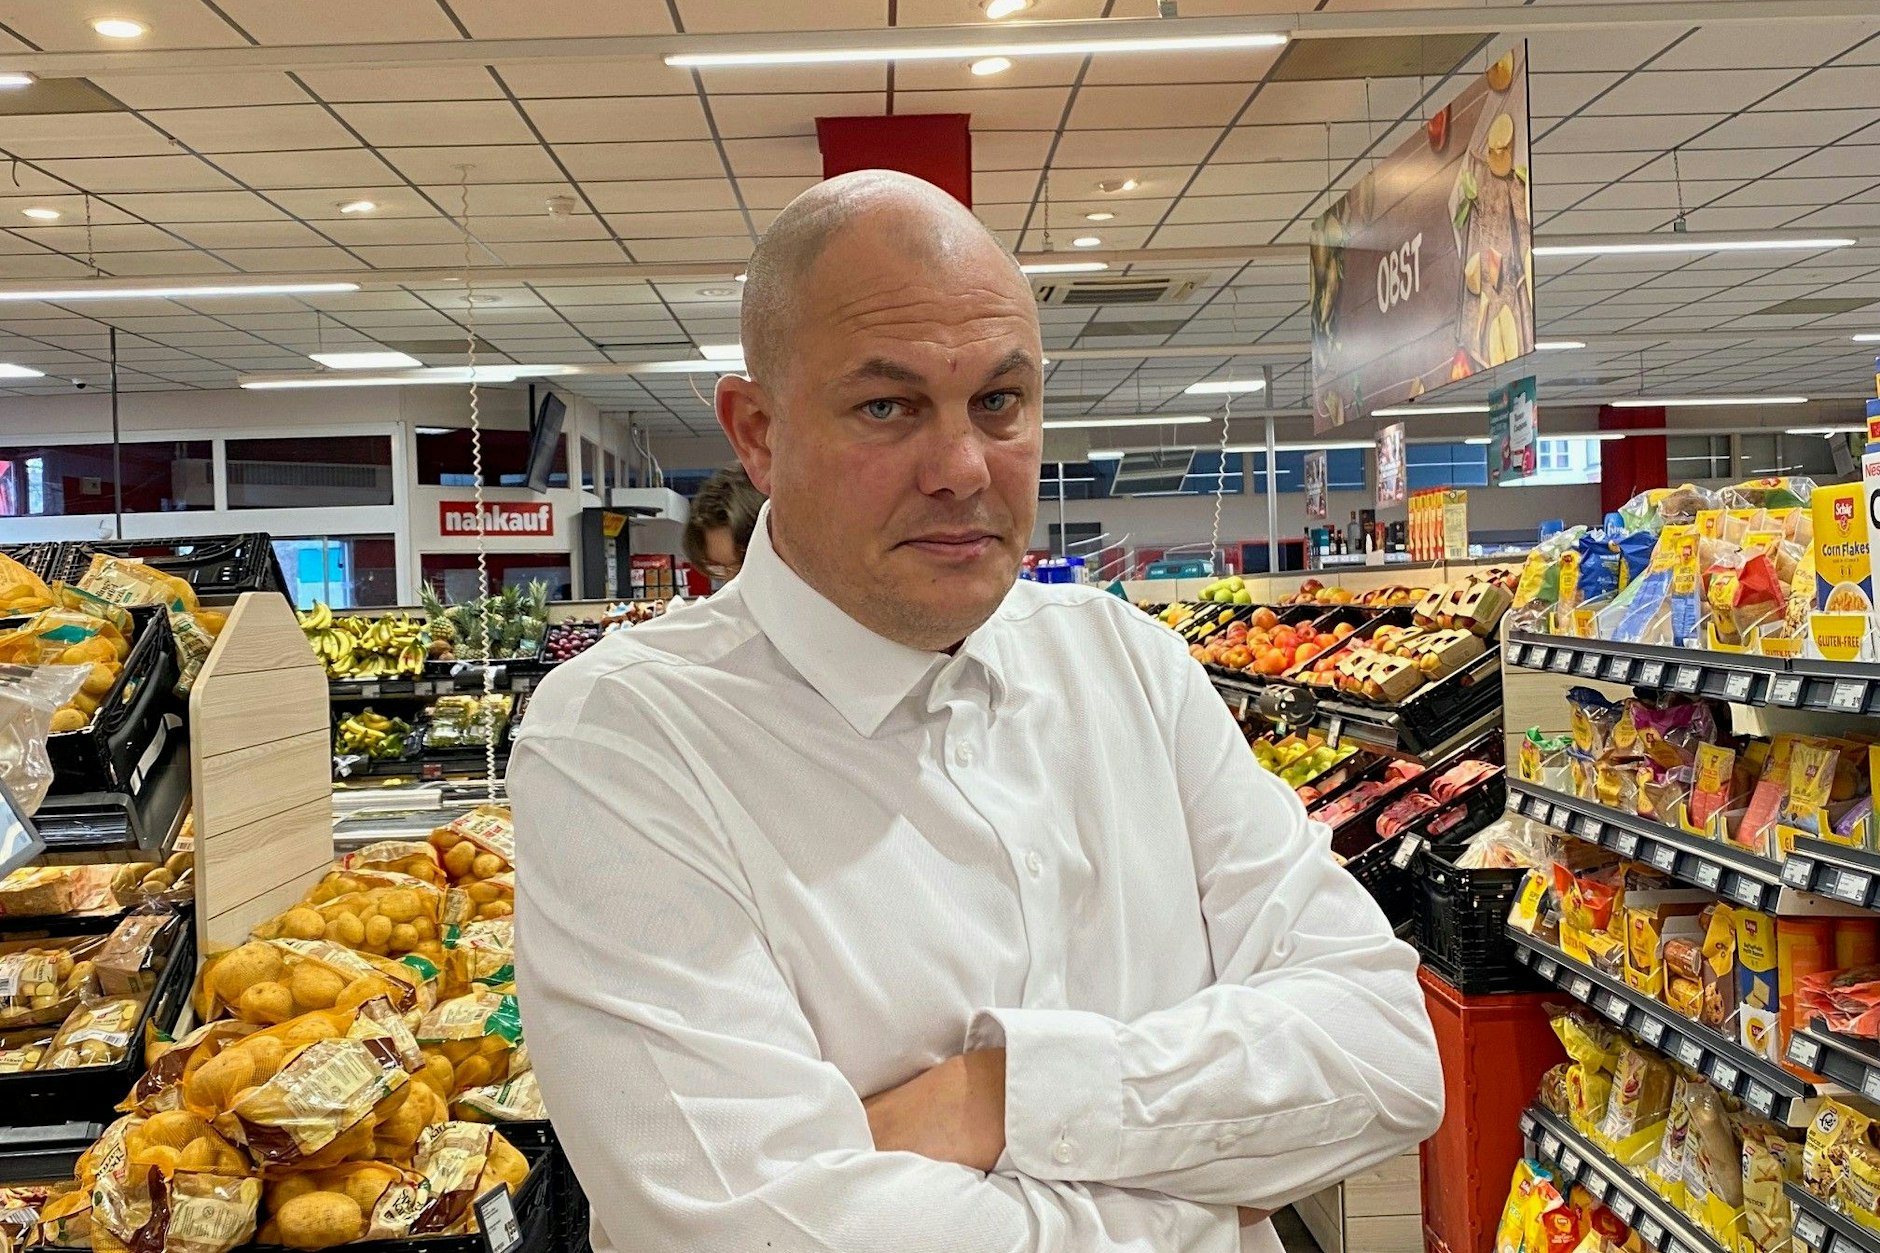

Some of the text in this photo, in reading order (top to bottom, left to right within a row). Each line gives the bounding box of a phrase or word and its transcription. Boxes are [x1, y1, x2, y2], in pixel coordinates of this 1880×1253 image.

[1377, 232, 1422, 313] OBST
[1822, 541, 1870, 557] Corn Flakes
[1818, 635, 1860, 648] GLUTEN-FREE
